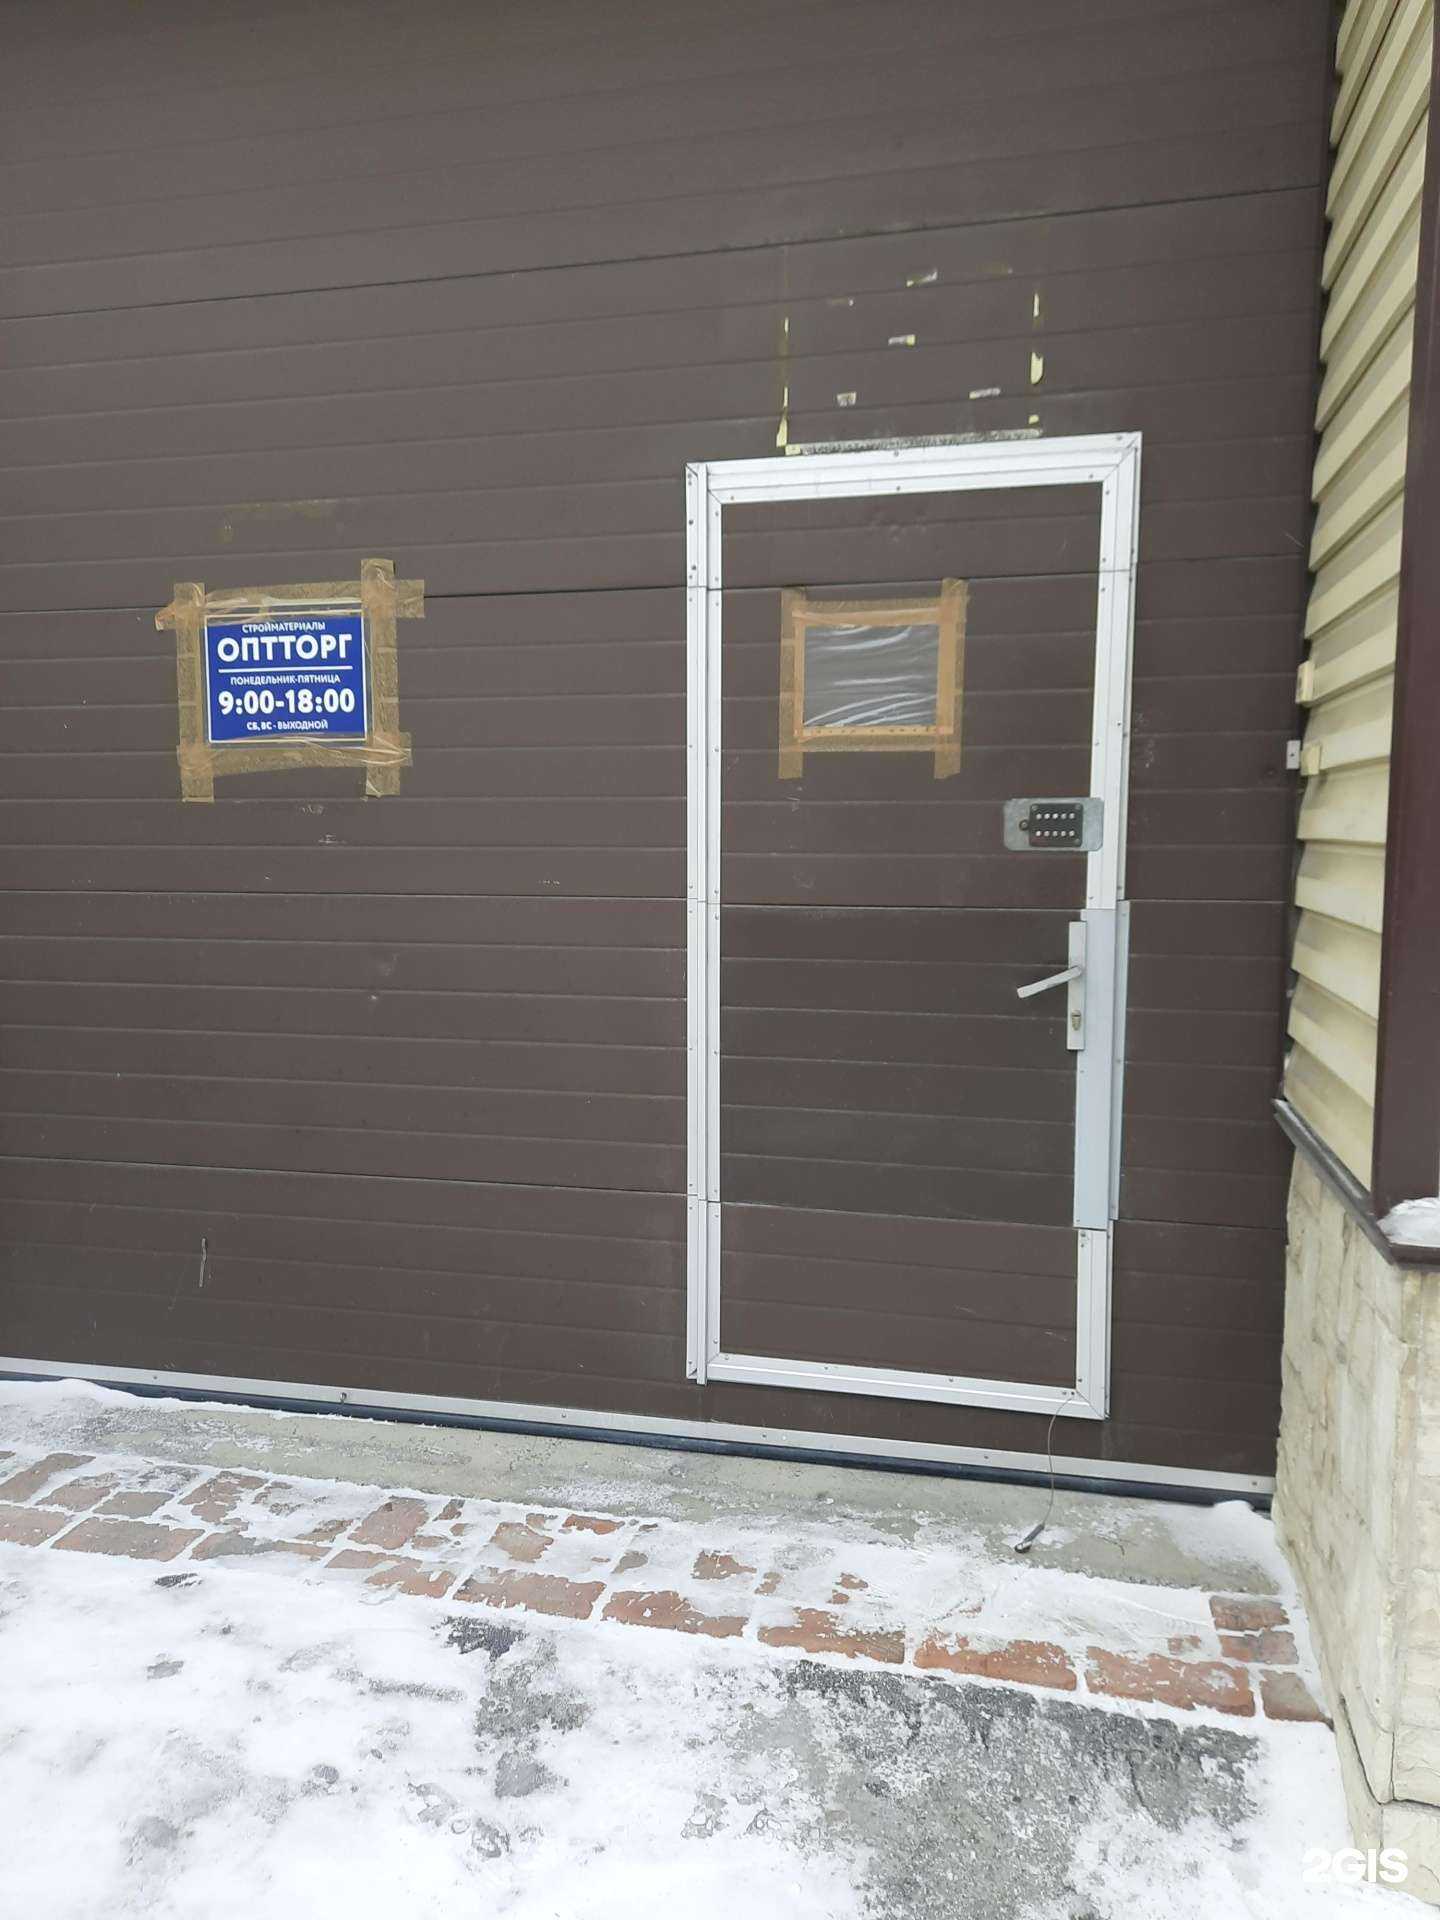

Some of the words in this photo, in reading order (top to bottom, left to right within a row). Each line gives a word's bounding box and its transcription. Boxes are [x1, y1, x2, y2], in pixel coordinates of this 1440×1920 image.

[241, 622, 326, 634] СТРОЙМАТЕРИАЛЫ
[217, 633, 353, 663] ОПТТОРГ
[230, 674, 341, 686] ПОНЕДЕЛЬНИК-ПЯТНИЦА
[218, 687, 356, 715] 9:00-18:00
[277, 719, 329, 730] ВЫХОДНОЙ
